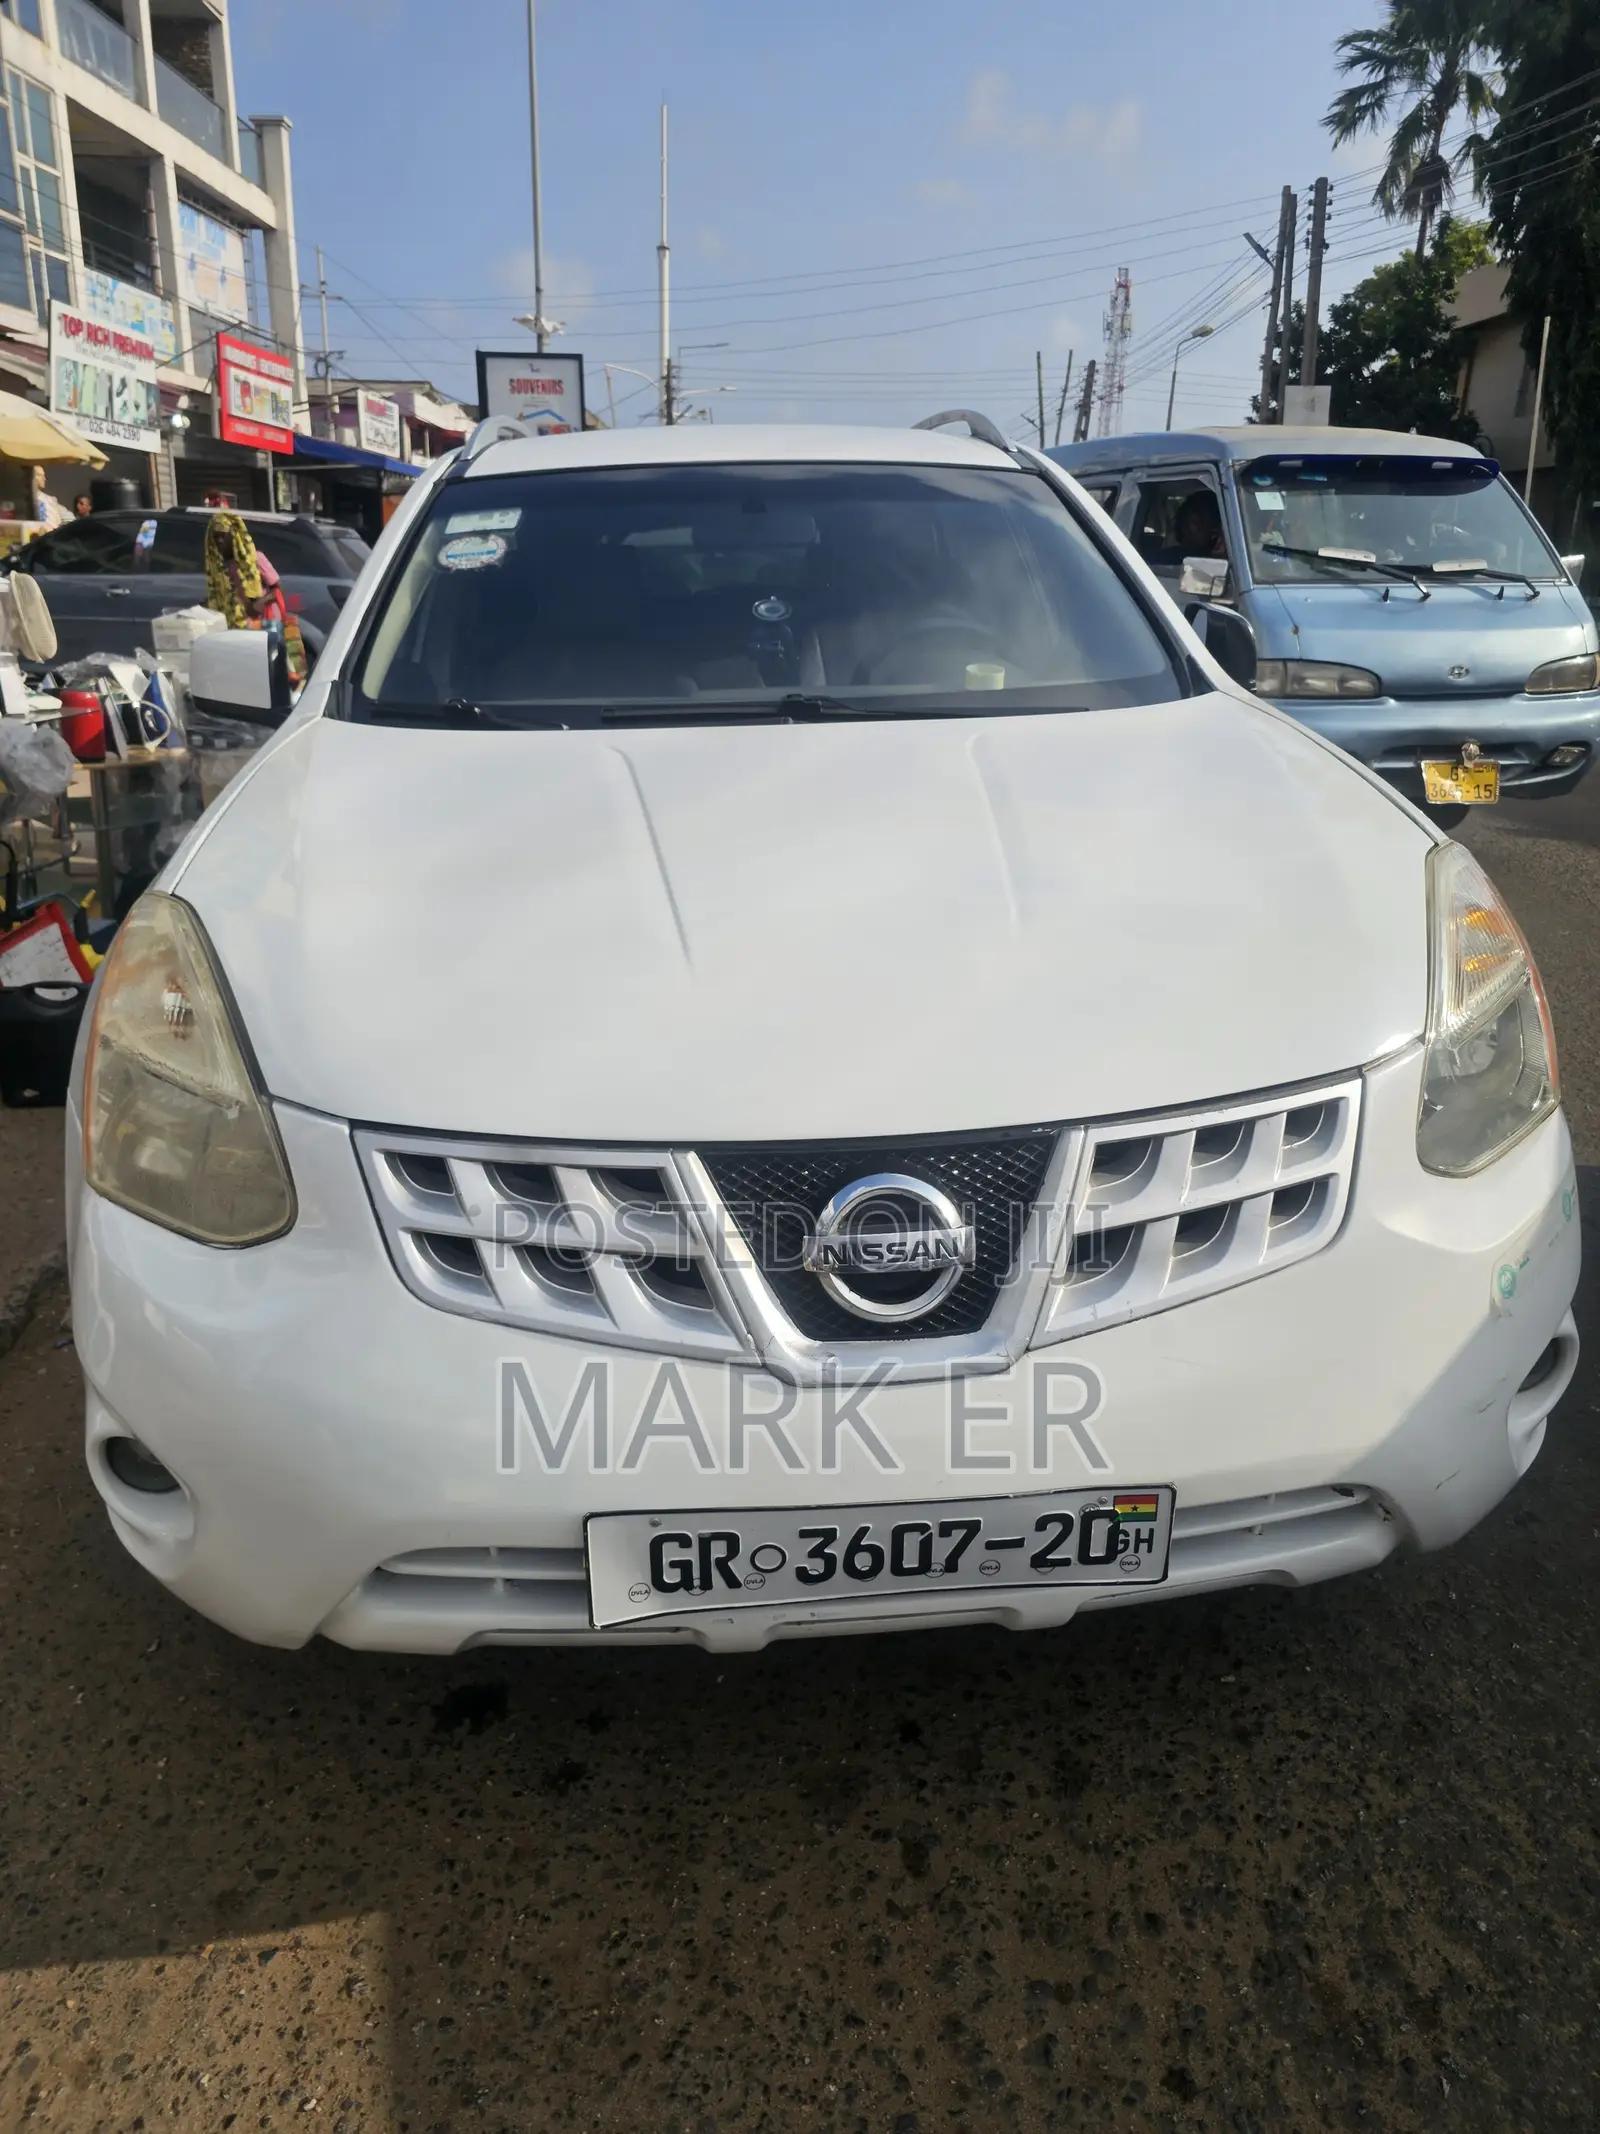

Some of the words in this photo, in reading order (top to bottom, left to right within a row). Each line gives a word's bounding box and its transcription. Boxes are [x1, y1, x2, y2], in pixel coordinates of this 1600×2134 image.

[60, 313, 84, 337] TOP
[86, 321, 110, 345] RICH
[509, 378, 564, 396] SOUVENIRS
[822, 1236, 960, 1267] NISSAN
[650, 1531, 743, 1594] GR
[795, 1508, 1121, 1585] 3607-20
[1115, 1527, 1155, 1555] GH
